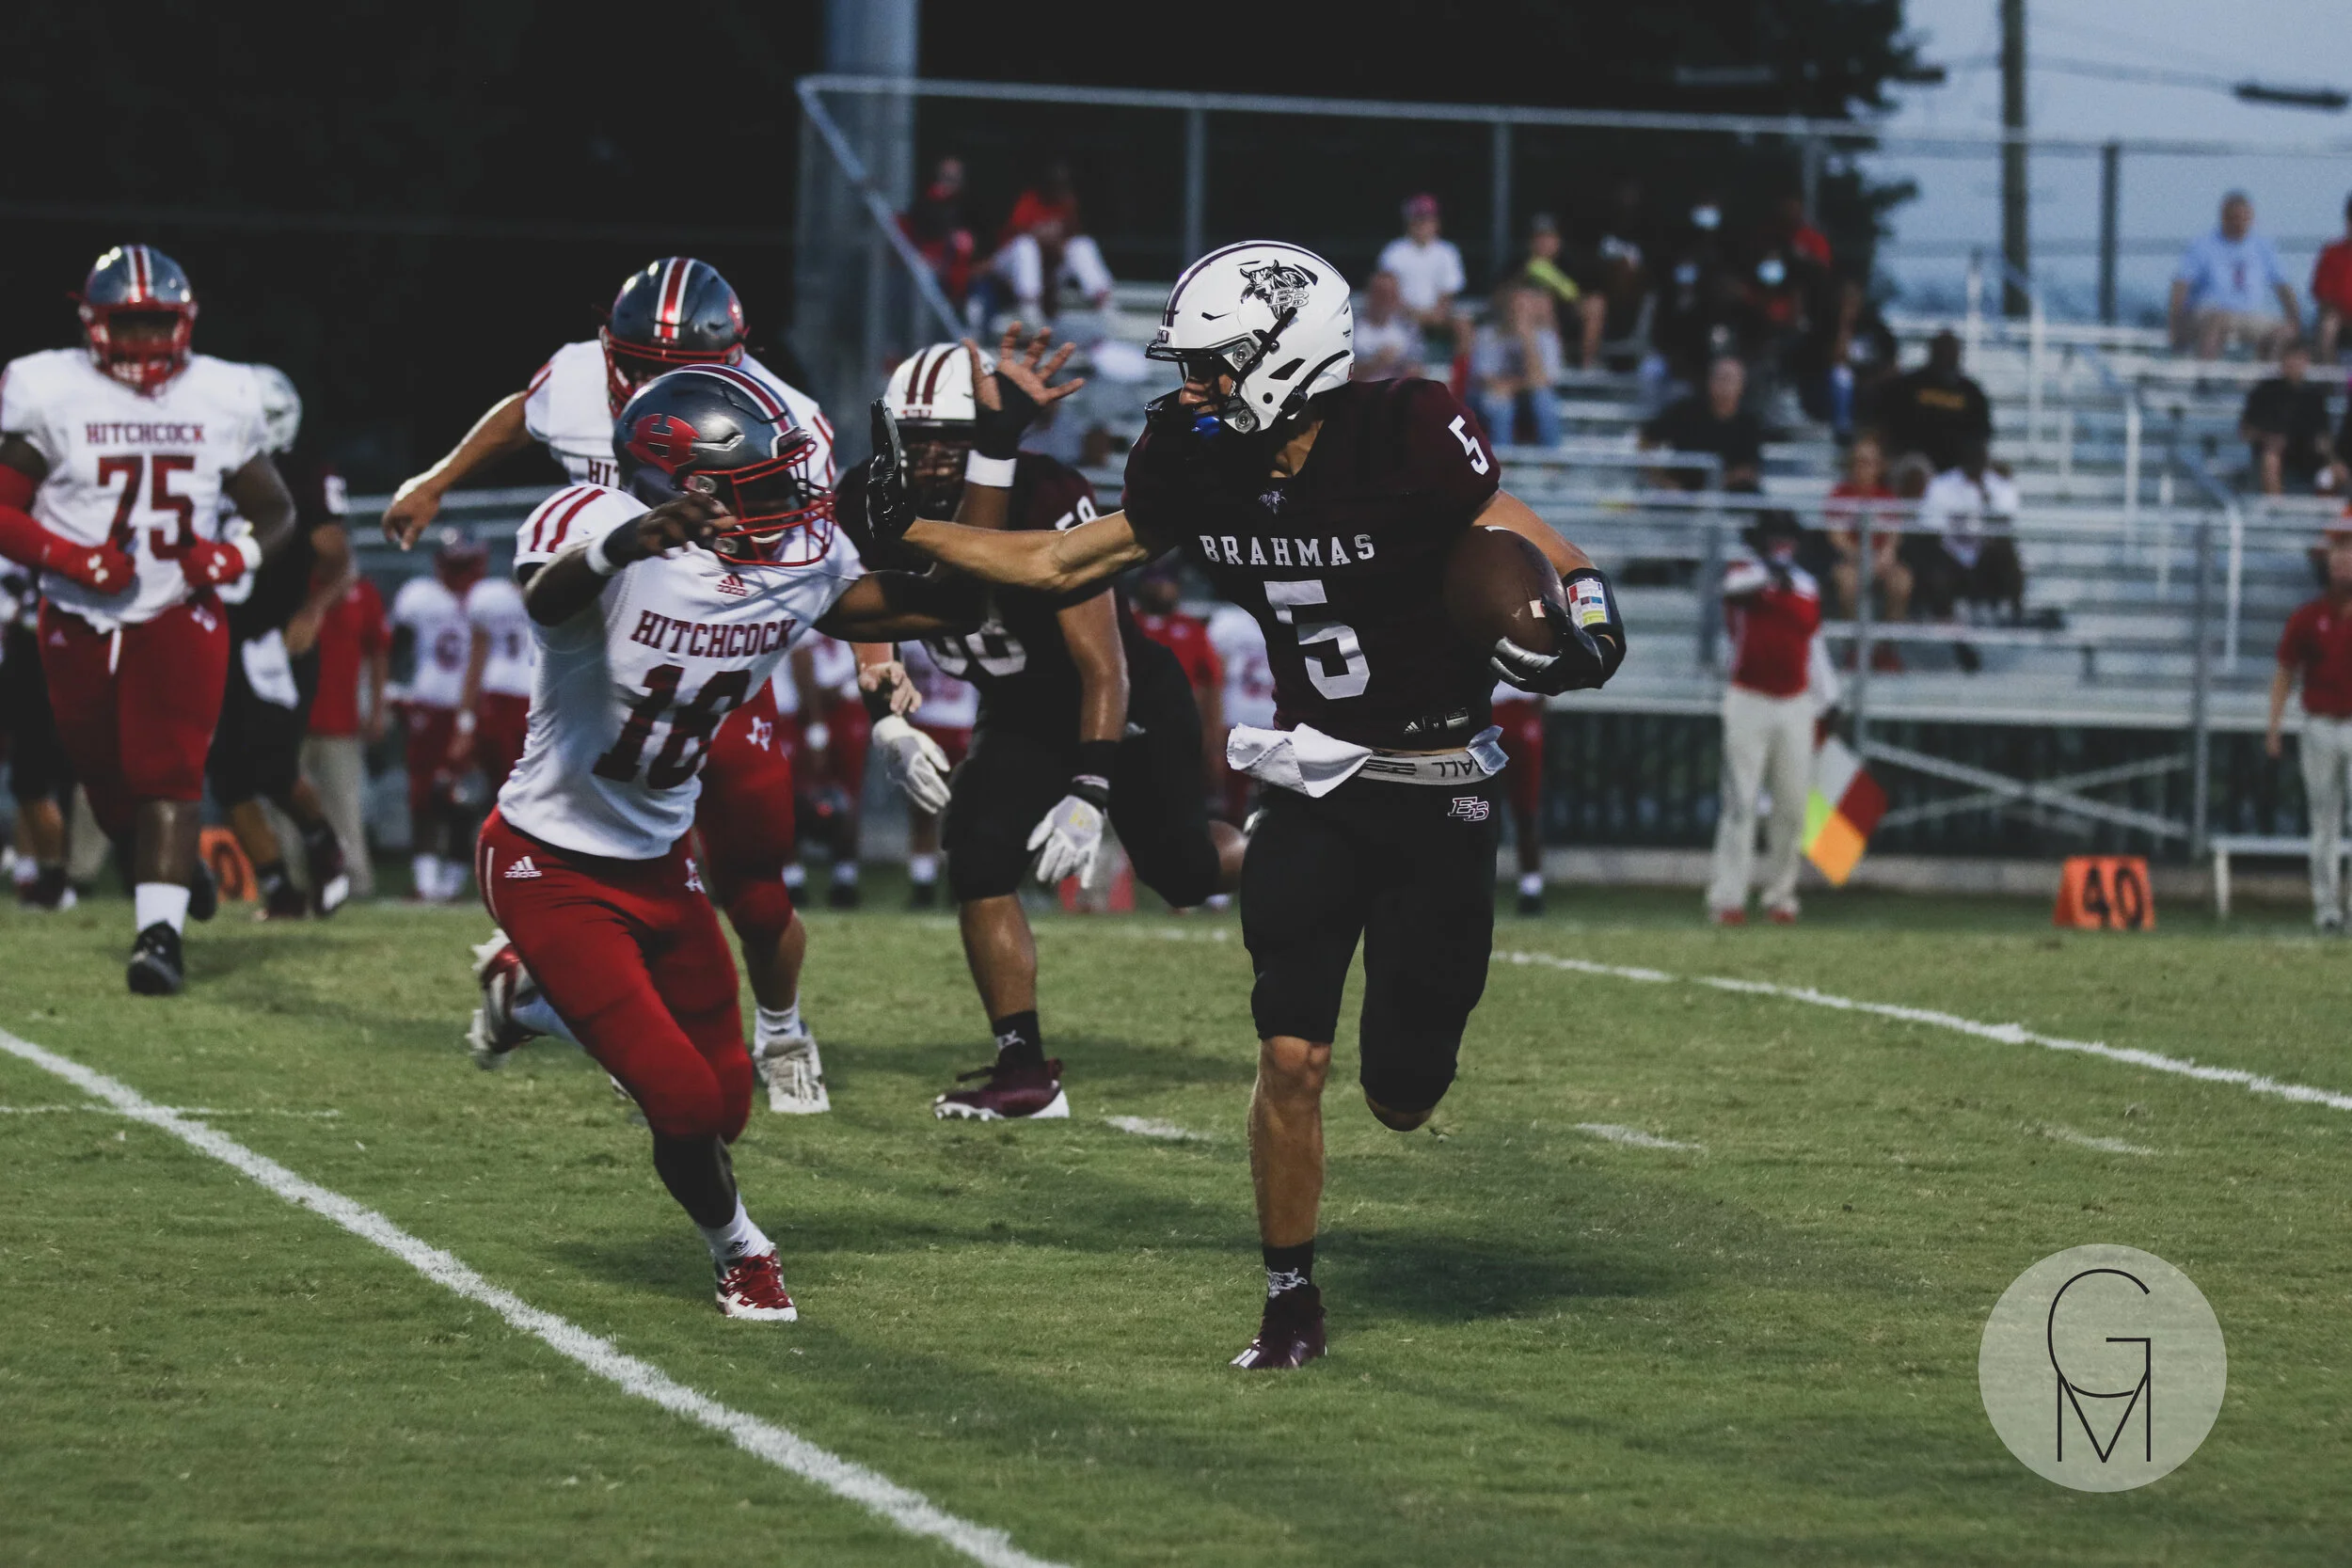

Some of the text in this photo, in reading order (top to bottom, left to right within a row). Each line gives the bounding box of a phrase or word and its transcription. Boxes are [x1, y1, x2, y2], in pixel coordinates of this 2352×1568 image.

[85, 423, 201, 445] HITCHCOCK
[1447, 414, 1490, 476] 5
[98, 453, 197, 561] 75
[1199, 533, 1375, 567] BRAHMAS
[629, 609, 799, 658] HITCHCOCK
[1263, 578, 1372, 701] 5
[1447, 796, 1490, 822] EB
[2081, 864, 2142, 929] 40
